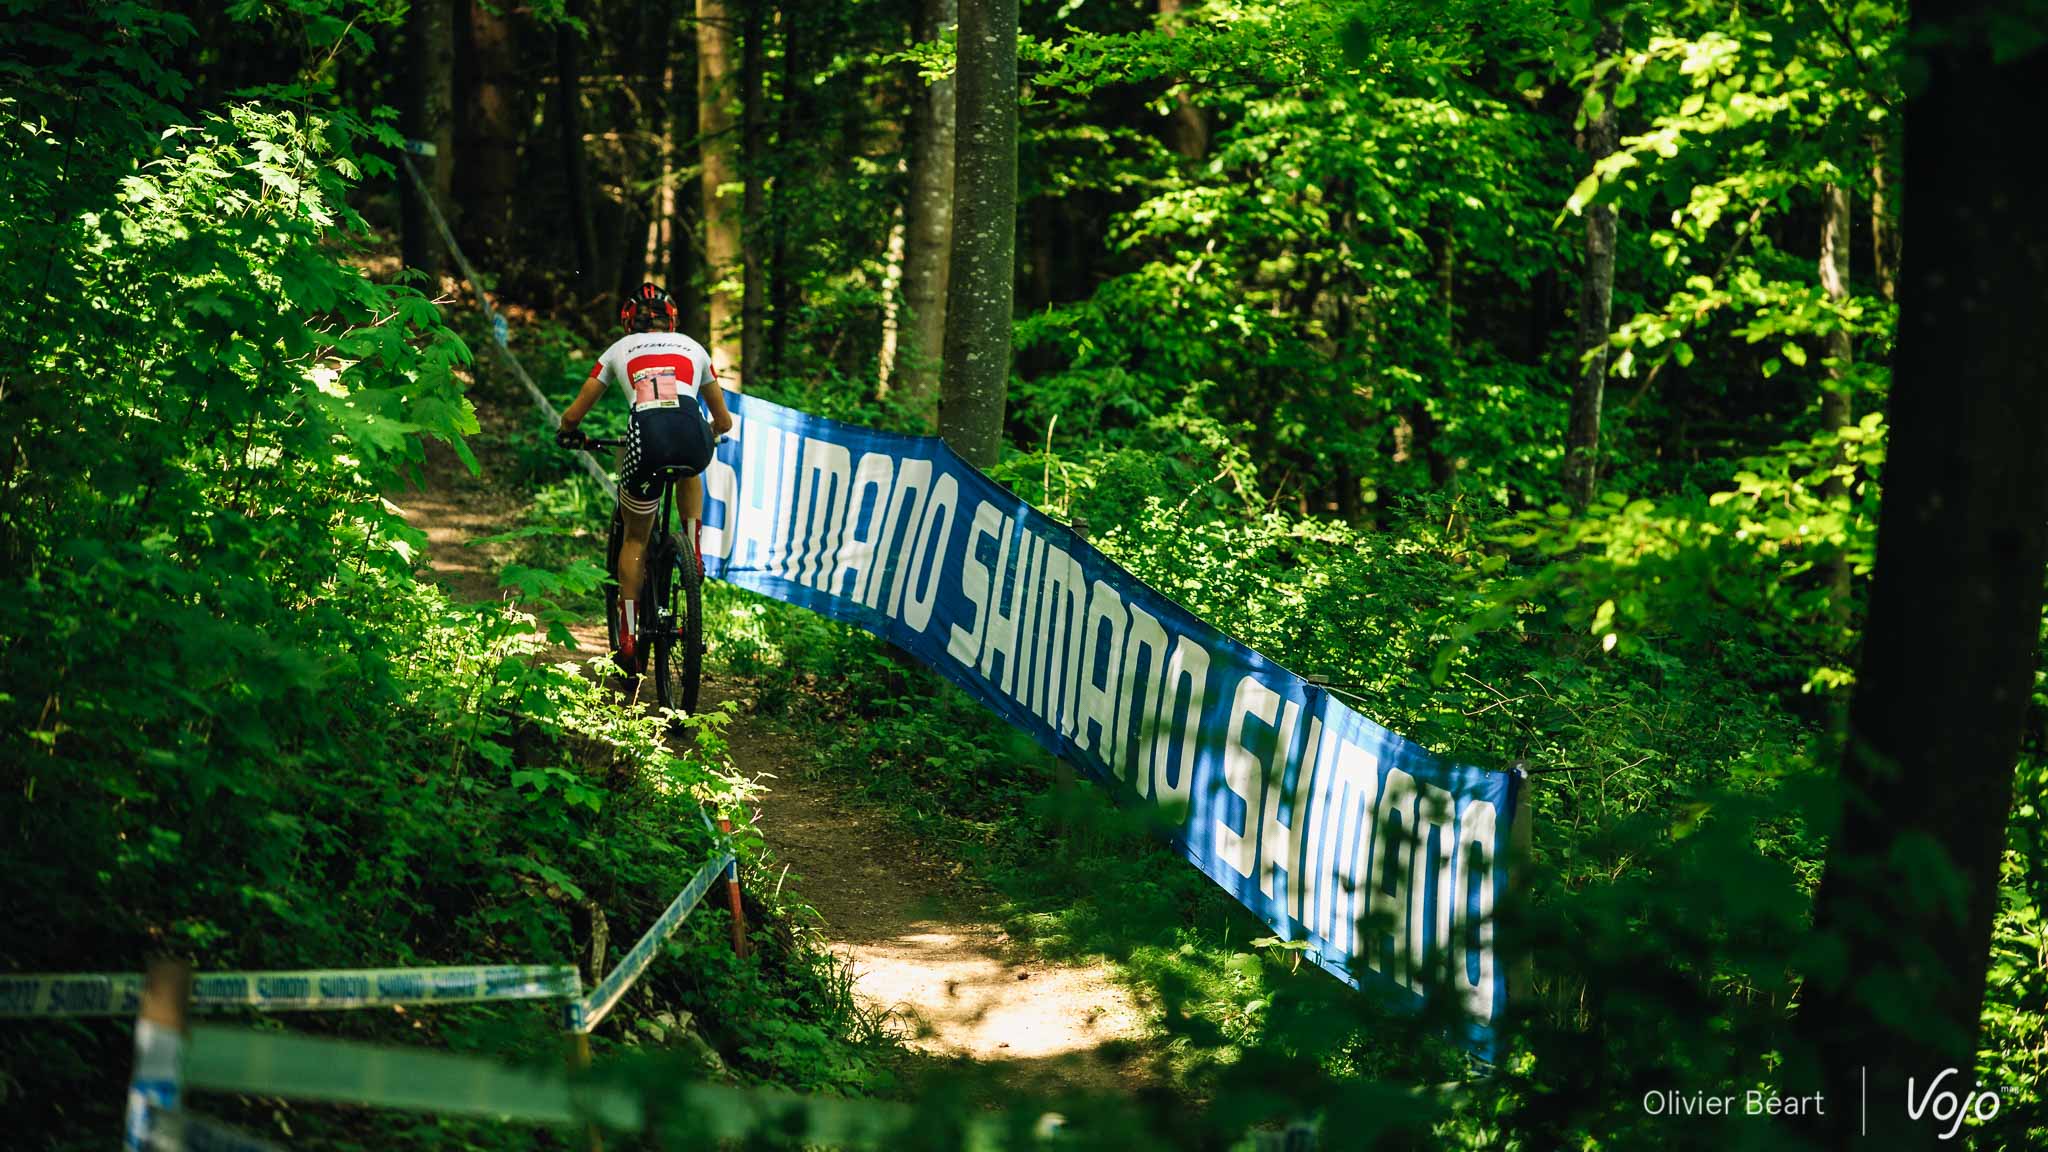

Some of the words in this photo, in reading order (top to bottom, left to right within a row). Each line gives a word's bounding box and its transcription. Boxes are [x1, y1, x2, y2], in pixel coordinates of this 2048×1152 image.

[650, 377, 659, 400] 1
[700, 410, 959, 633] SHIMANO
[947, 499, 1211, 825] SHIMANO
[1215, 675, 1497, 1027] SHIMANO
